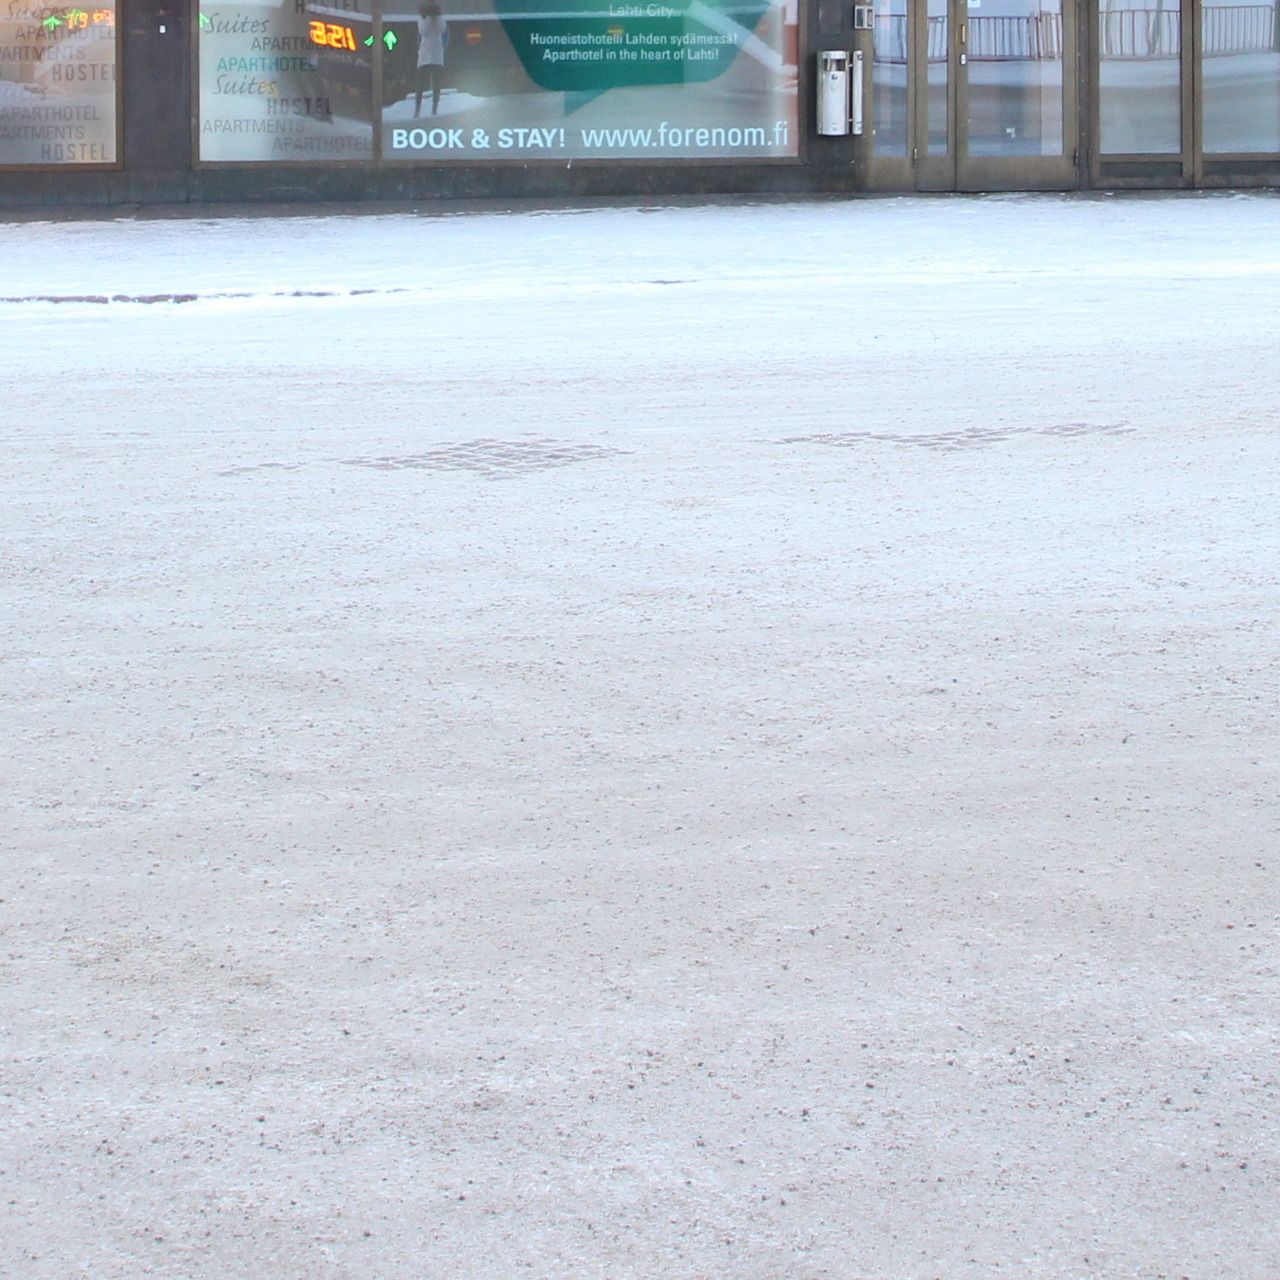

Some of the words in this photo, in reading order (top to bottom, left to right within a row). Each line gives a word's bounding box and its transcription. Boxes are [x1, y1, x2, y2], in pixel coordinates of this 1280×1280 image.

[609, 4, 642, 16] Lahti
[646, 3, 674, 18] City
[205, 13, 270, 34] Suites
[530, 33, 623, 45] Huoneistohotelli
[626, 32, 667, 45] Lahden
[670, 32, 738, 47] sydämessä!
[543, 49, 603, 61] Aparthotel
[606, 49, 618, 60] in
[620, 49, 637, 60] the
[640, 49, 669, 60] heart
[672, 49, 685, 60] of
[687, 49, 719, 61] Lahti!
[217, 57, 317, 71] APARTHOTEL
[212, 74, 277, 95] Suites
[0, 106, 100, 121] APARTHOTEL
[267, 97, 333, 115] HOSTEL
[203, 119, 305, 134] APARTMENTS
[392, 129, 464, 149] BOOK
[471, 128, 490, 148] &
[497, 127, 565, 148] STAY!
[581, 121, 789, 148] www.forenom.fi
[272, 136, 372, 152] APARTHOTEL
[41, 143, 108, 161] HOSTEL
